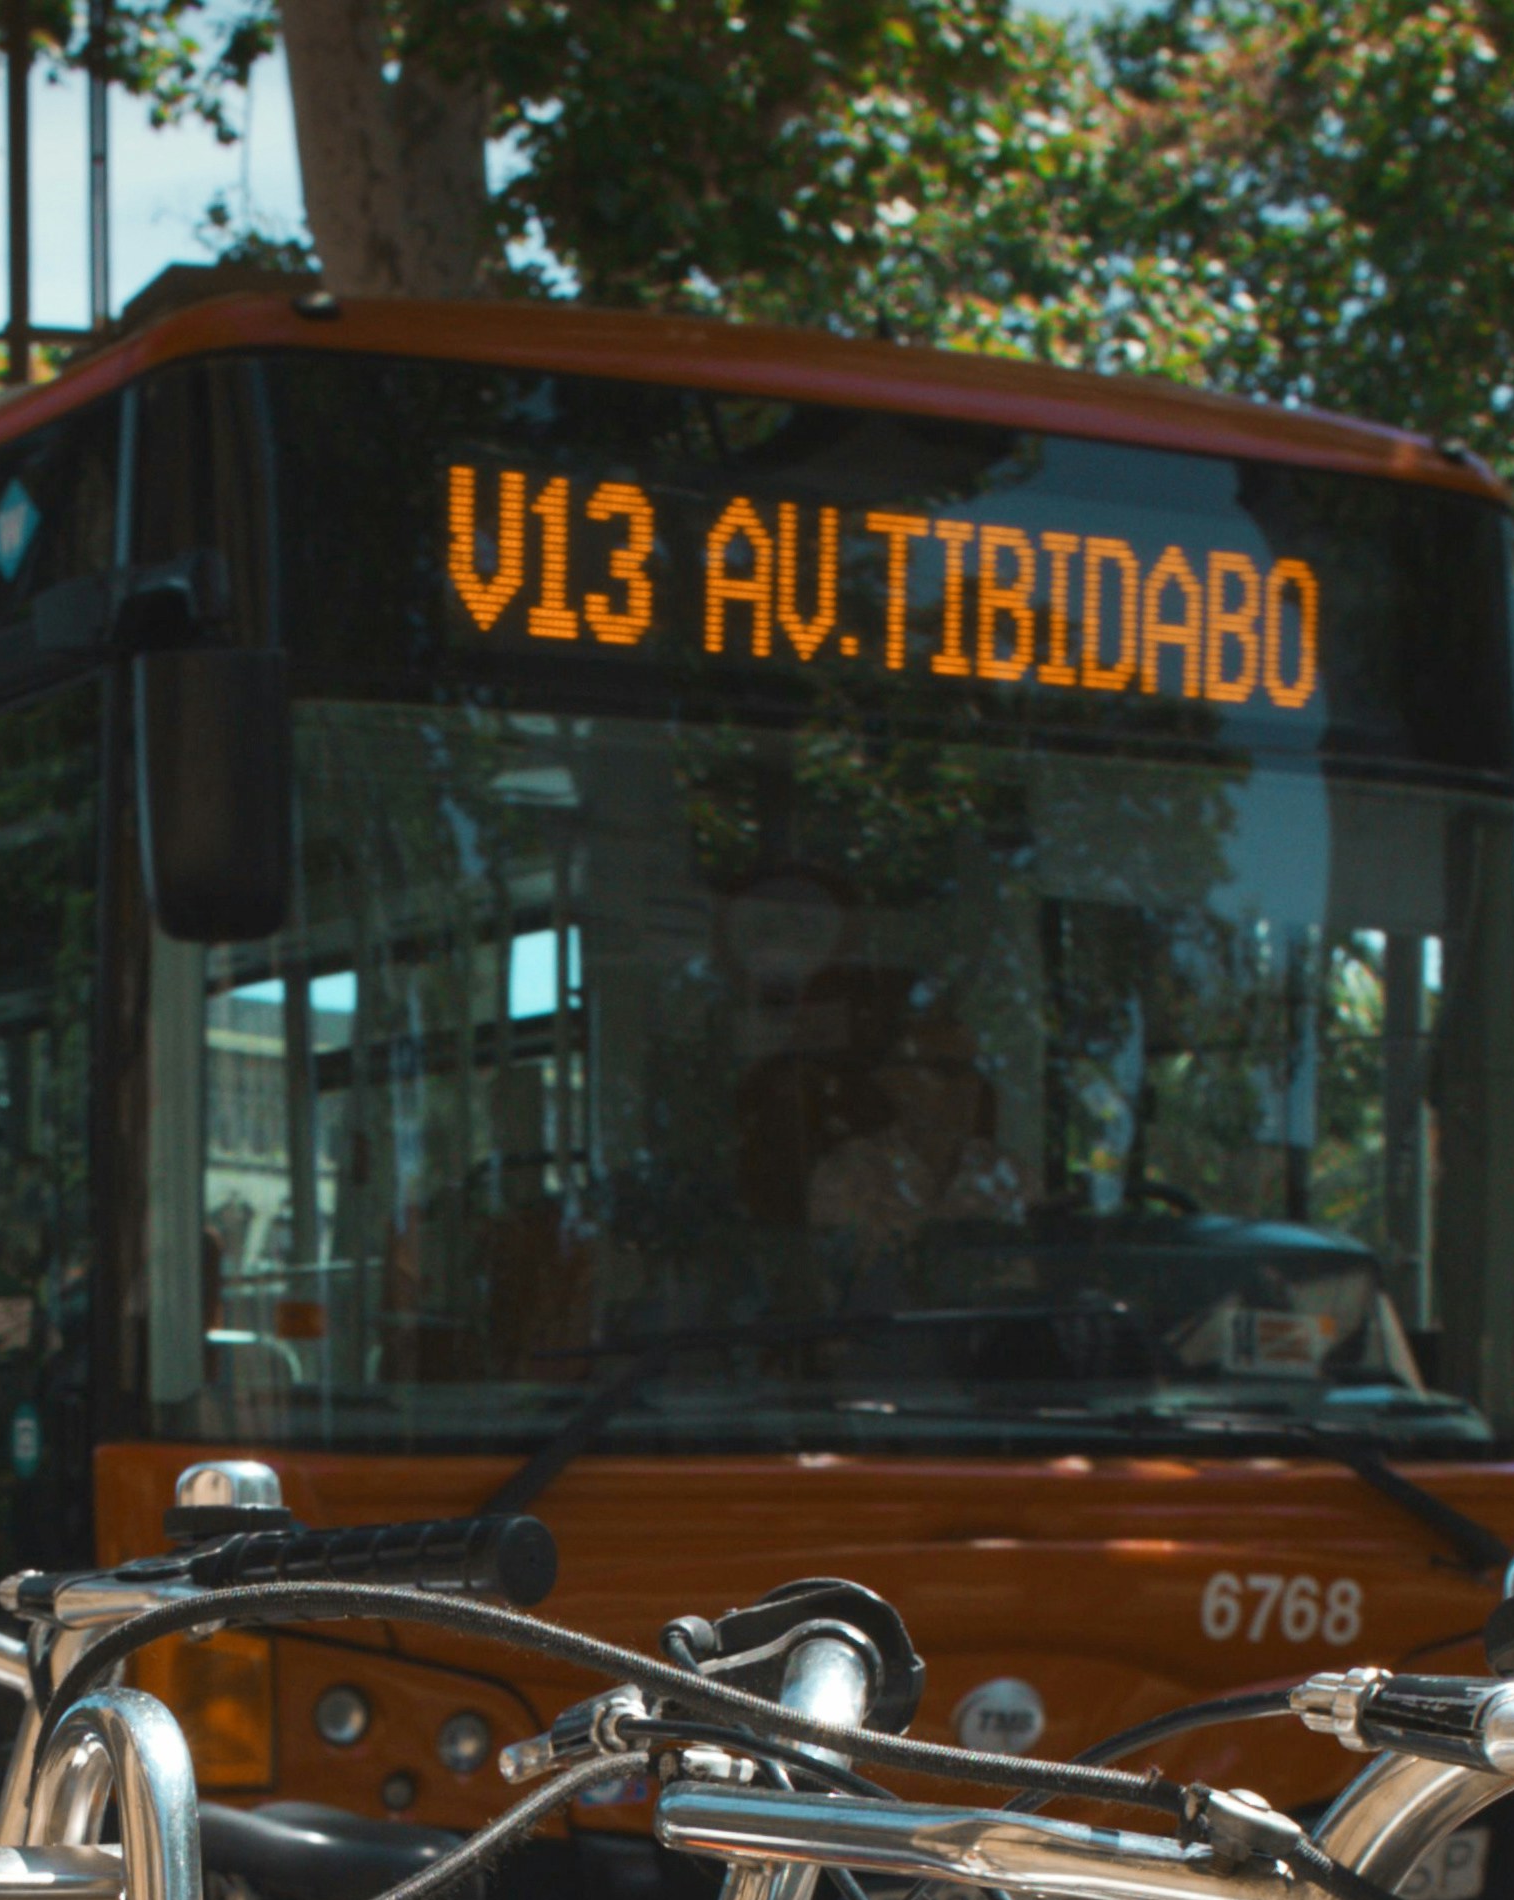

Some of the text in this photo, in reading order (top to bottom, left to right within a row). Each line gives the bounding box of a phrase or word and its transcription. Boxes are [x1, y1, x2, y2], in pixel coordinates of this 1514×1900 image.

[447, 465, 1319, 709] V13 AV.TIBIDABO
[1200, 1571, 1363, 1646] 6768
